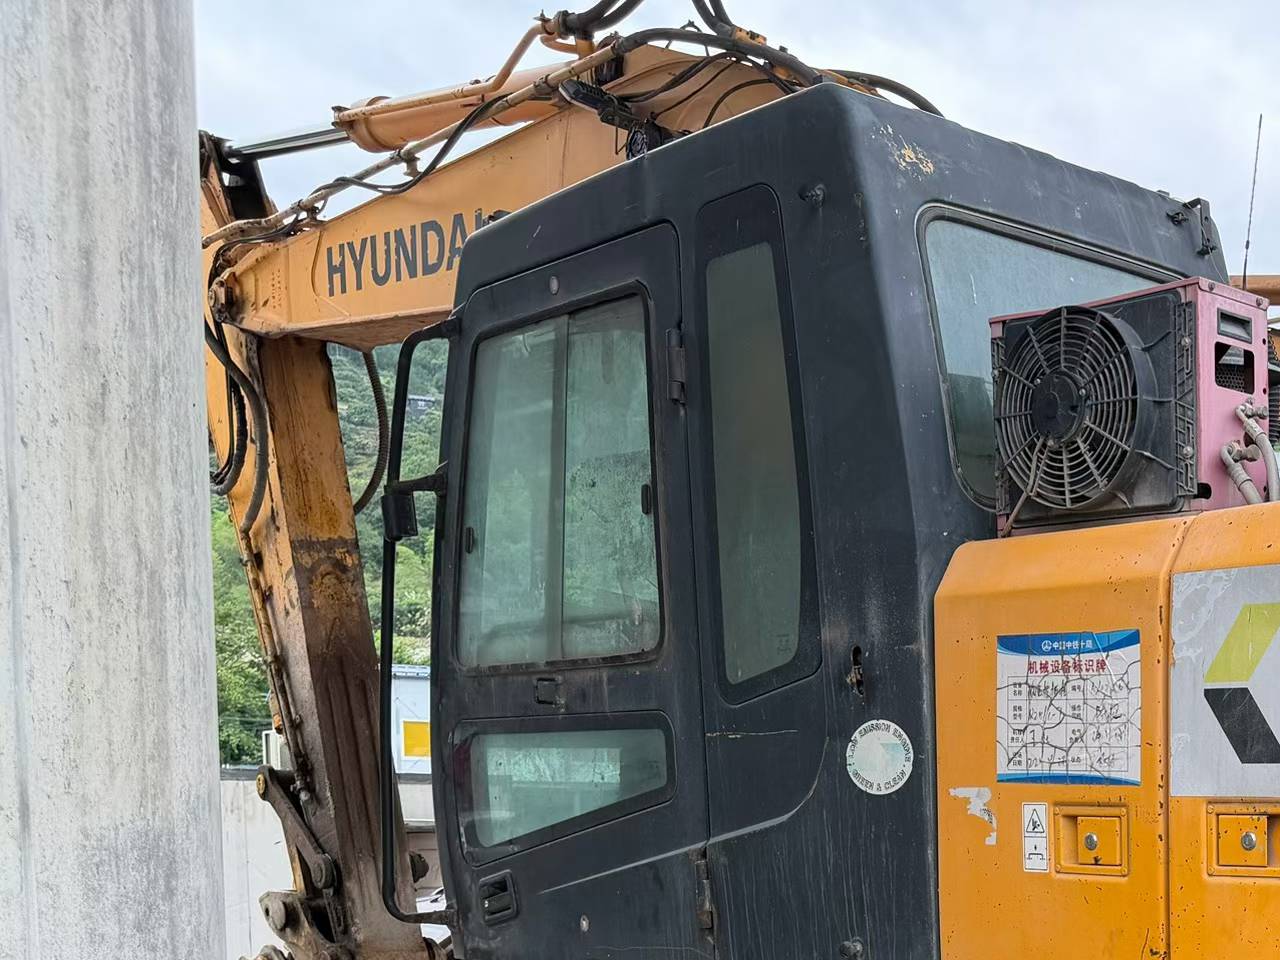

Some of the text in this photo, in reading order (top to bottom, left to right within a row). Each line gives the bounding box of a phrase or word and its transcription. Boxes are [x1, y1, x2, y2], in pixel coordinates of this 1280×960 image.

[1029, 658, 1107, 674] 机械设备标识牌
[859, 723, 891, 738] EMISSION
[893, 728, 911, 762] ENGINE
[853, 769, 874, 790] GREEN
[884, 770, 906, 789] CLEAN
